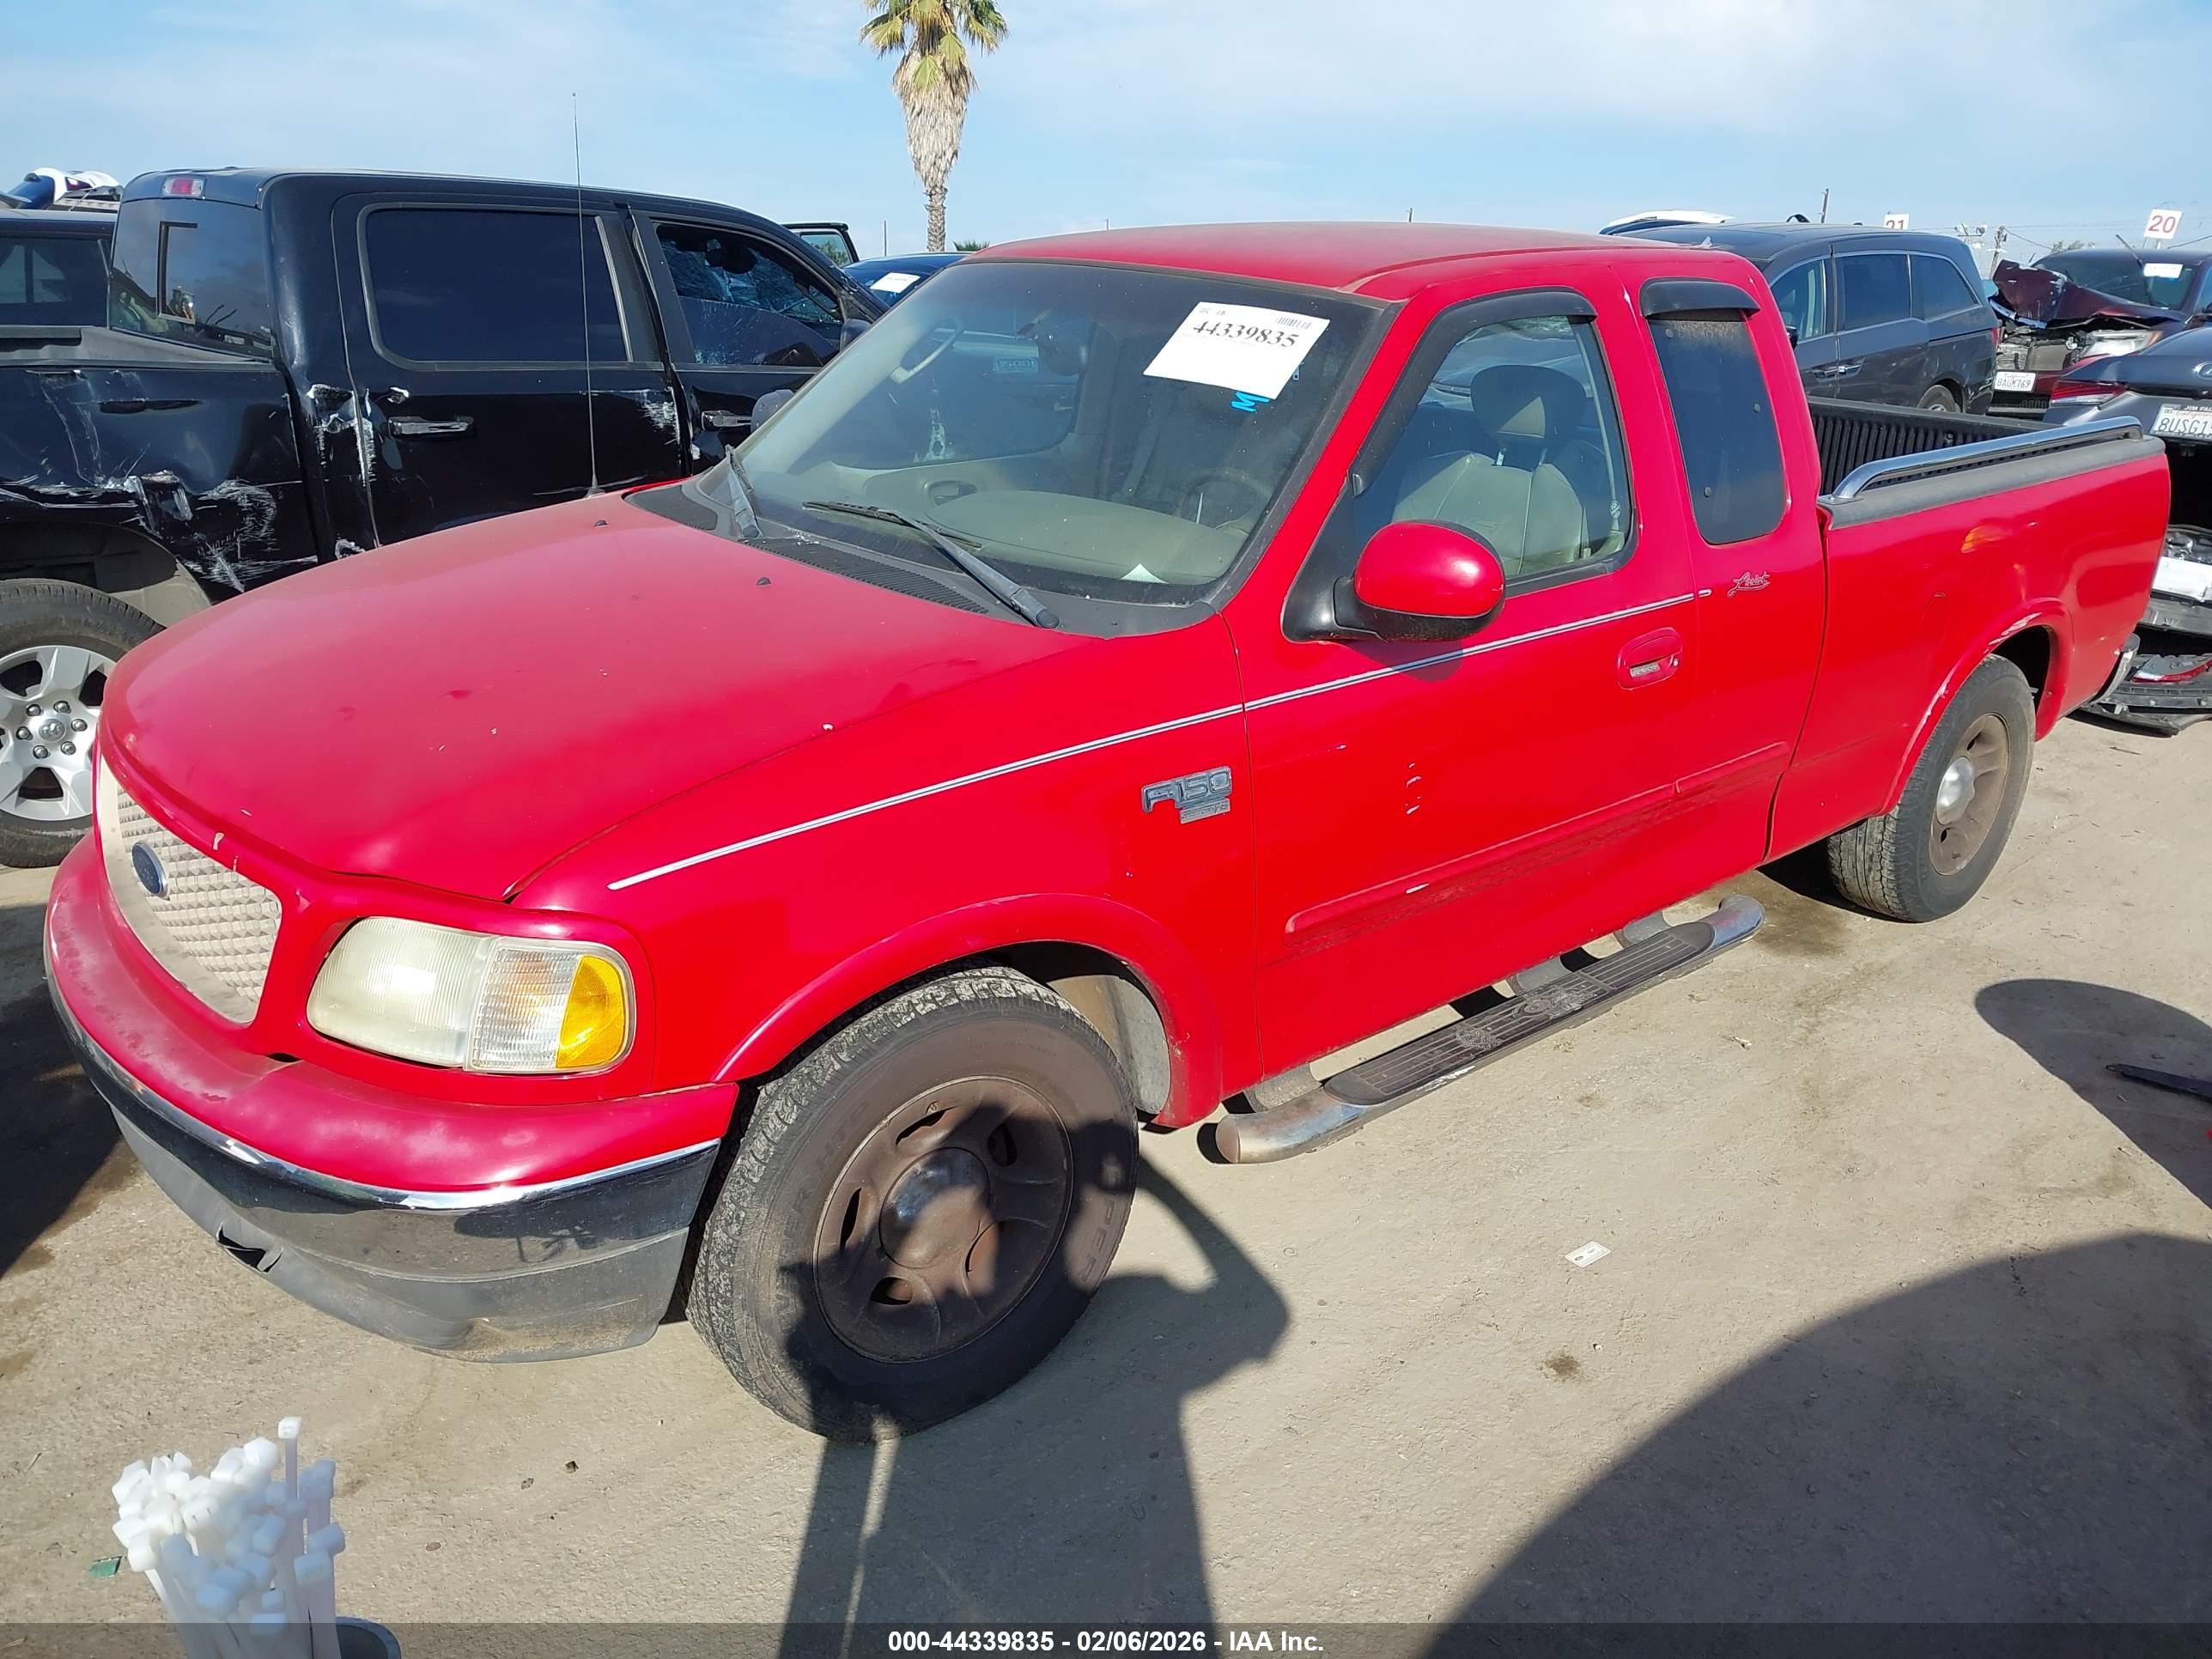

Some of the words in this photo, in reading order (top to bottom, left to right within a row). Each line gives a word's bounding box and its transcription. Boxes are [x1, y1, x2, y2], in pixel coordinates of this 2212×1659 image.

[2148, 215, 2176, 233] 20
[1194, 320, 1299, 347] 44339835
[2158, 417, 2212, 434] 8USG1
